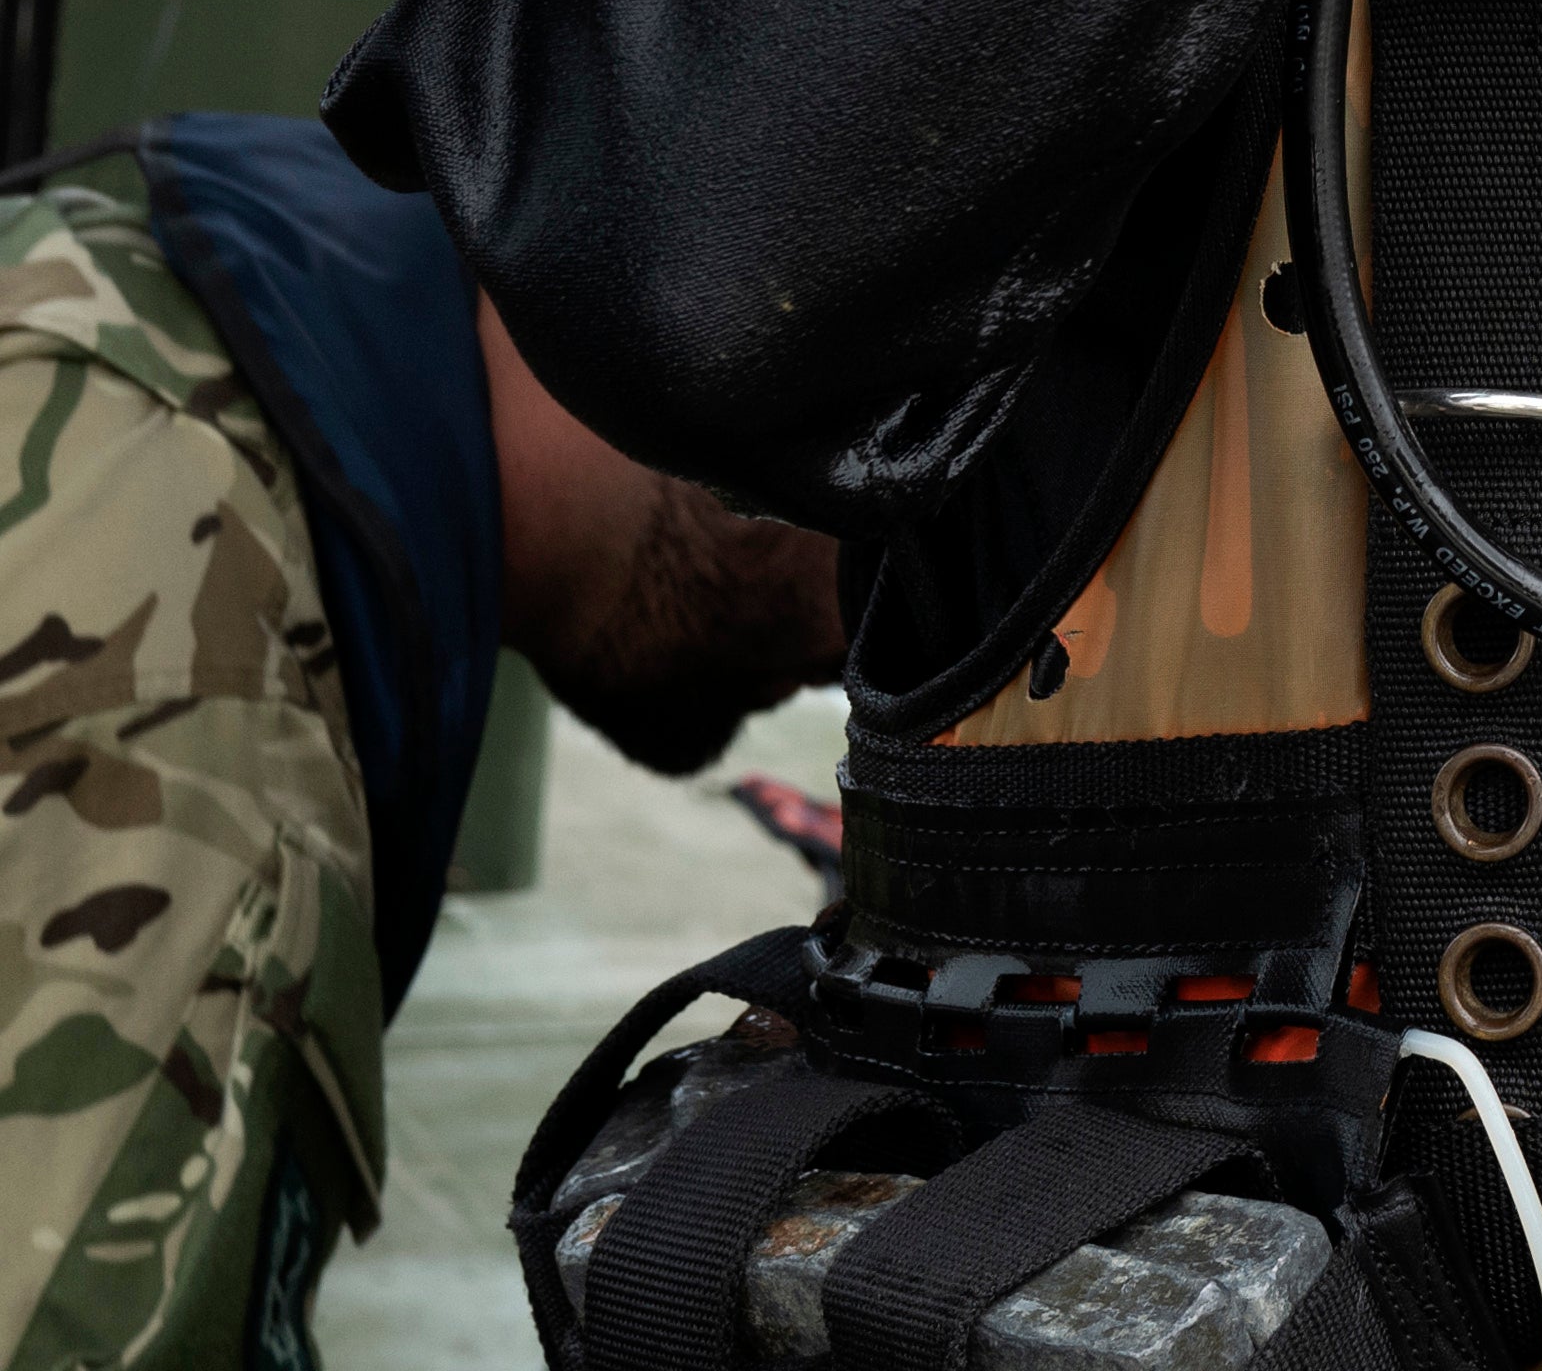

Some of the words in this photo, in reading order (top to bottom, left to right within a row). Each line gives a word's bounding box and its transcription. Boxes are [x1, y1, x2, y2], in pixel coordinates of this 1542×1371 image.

[1332, 382, 1363, 427] PSI
[1357, 437, 1390, 480] 250
[1434, 545, 1528, 621] EXCEED
